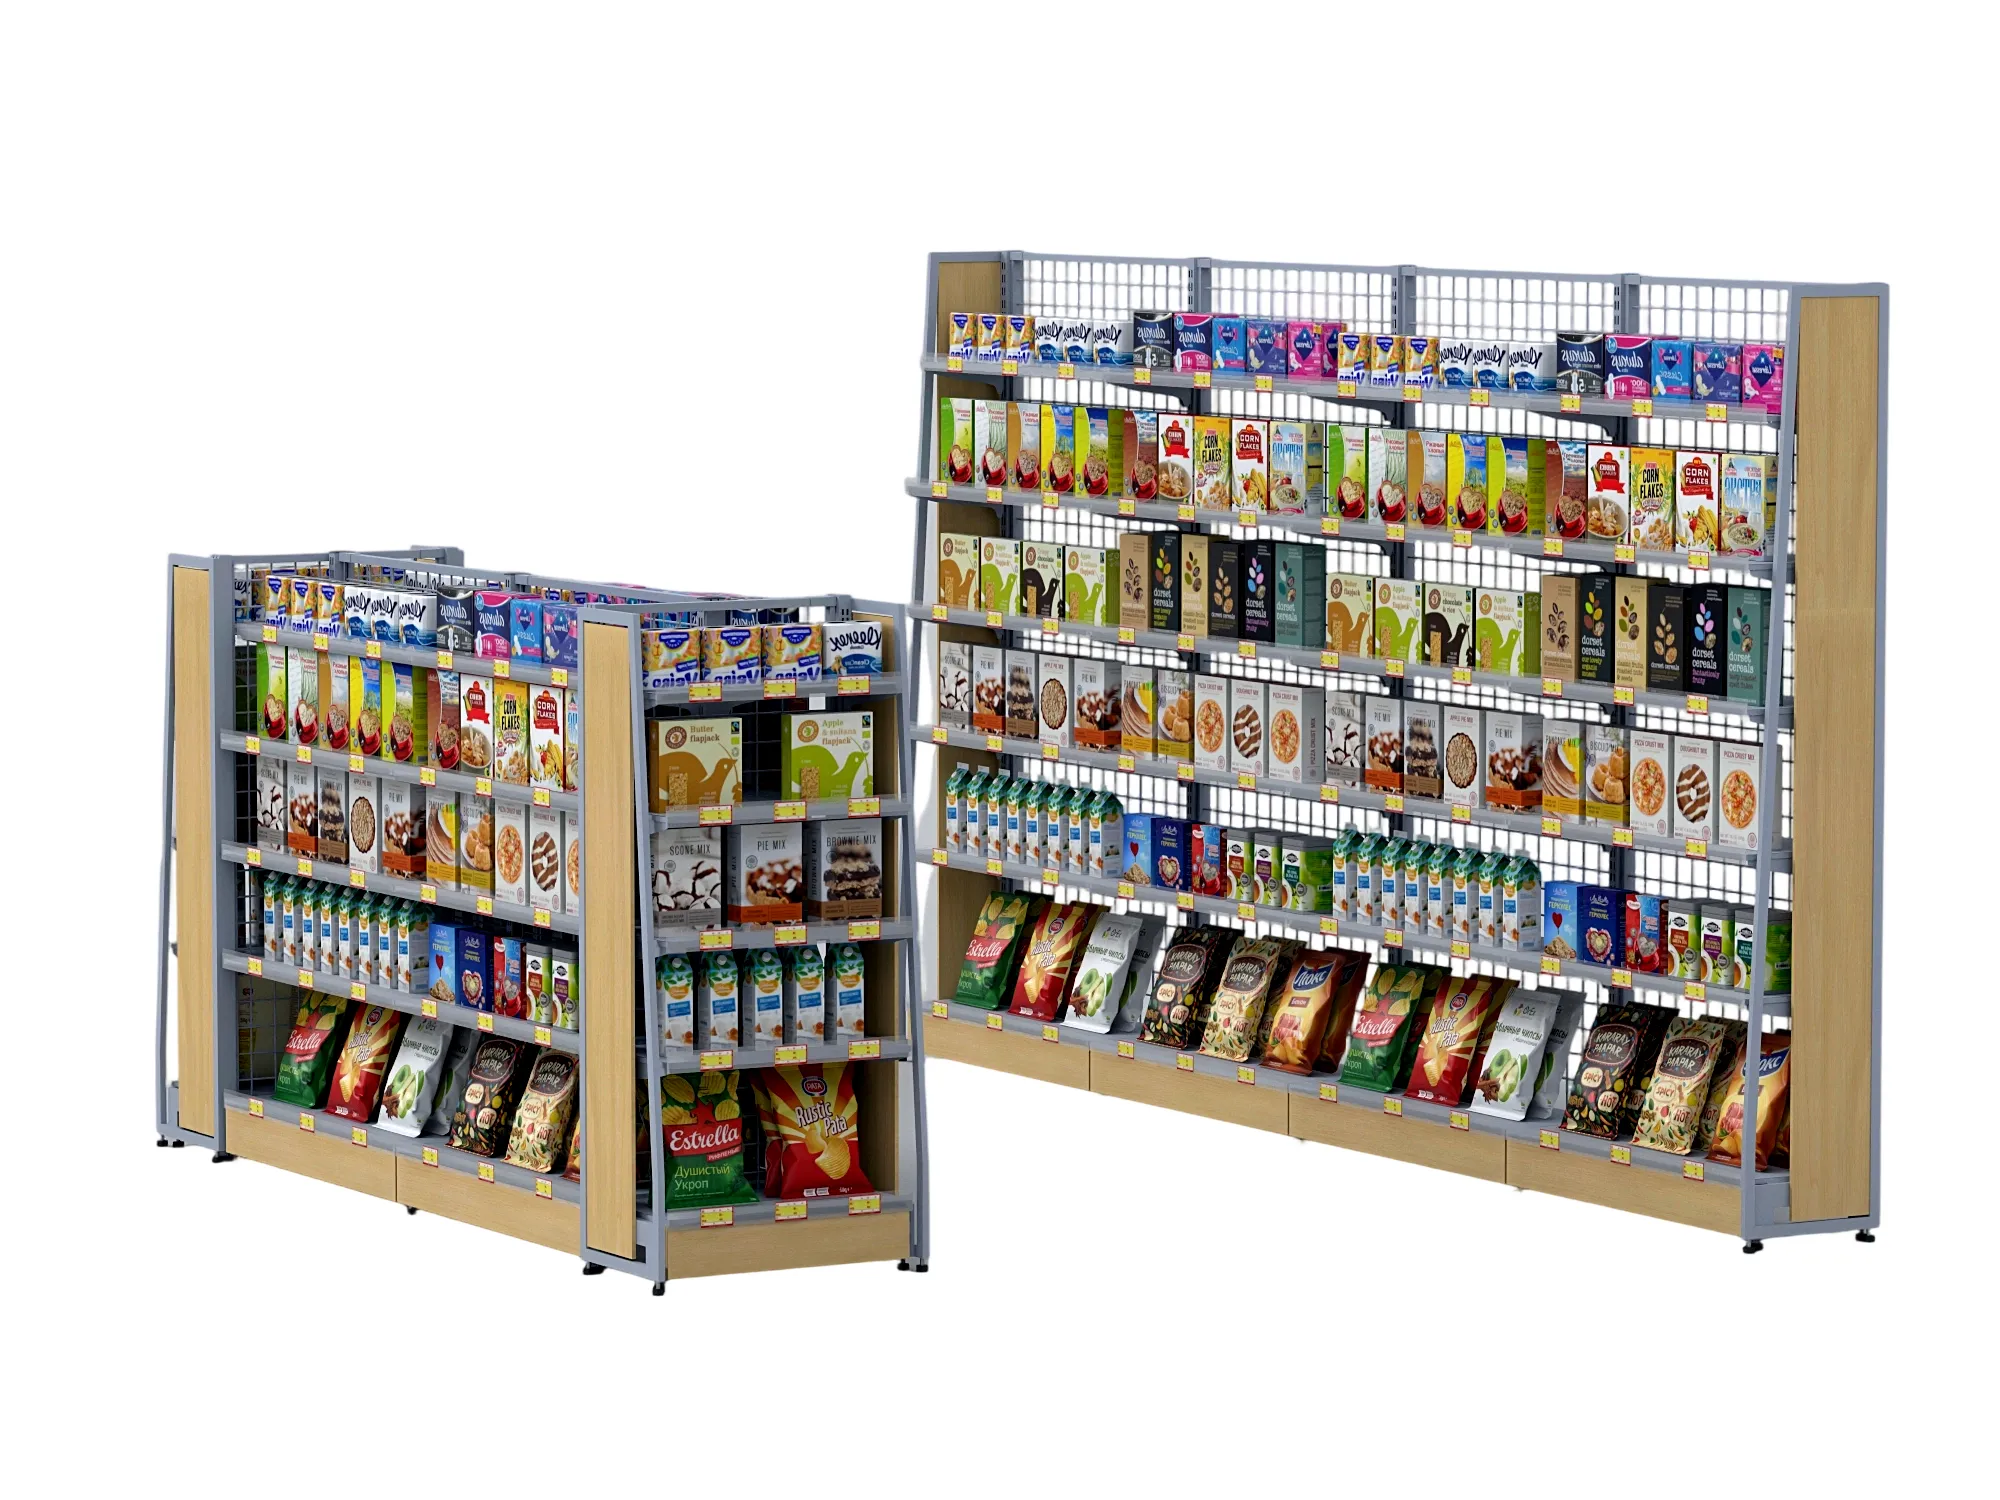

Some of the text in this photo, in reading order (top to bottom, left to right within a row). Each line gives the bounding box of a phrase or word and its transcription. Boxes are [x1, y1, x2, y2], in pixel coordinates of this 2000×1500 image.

[1204, 435, 1218, 449] CORN
[1240, 434, 1260, 443] CORN
[1202, 449, 1222, 463] FLAKES
[1642, 467, 1659, 483] CORN
[1685, 467, 1709, 477] CORN
[1685, 477, 1709, 485] FLAKES
[1639, 484, 1663, 499] FLAKES
[1153, 588, 1172, 597] dorset
[1153, 598, 1174, 608] cereals
[1245, 598, 1264, 608] dorset
[1276, 601, 1295, 611] dorset
[1245, 608, 1267, 618] cereals
[1276, 612, 1298, 622] cereals
[1581, 635, 1603, 646] dorset
[1616, 638, 1637, 649] dorset
[1581, 647, 1605, 657] cereals
[1616, 650, 1640, 661] cereals
[1692, 647, 1714, 658] dorset
[1729, 651, 1752, 663] dorset
[1666, 663, 1680, 671] cereals
[1692, 658, 1717, 670] cereals
[1729, 663, 1754, 674] cereals
[504, 700, 517, 715] CORN
[537, 700, 556, 711] CORN
[537, 710, 556, 719] FLAKES
[1374, 712, 1391, 722] PIE MIX
[1450, 714, 1461, 722] APPLE
[501, 715, 520, 731] FLAKES
[822, 718, 844, 728] Apple
[690, 725, 714, 734] Butter
[1495, 727, 1513, 738] PIE MIX
[690, 733, 720, 745] flapjack
[822, 737, 852, 747] flapjack
[1545, 735, 1566, 746] PANCAKE
[1645, 739, 1655, 747] CRUST
[1590, 740, 1609, 751] BISCUIT
[1680, 745, 1707, 754] DOUGHNUT MIX
[1735, 752, 1746, 760] CRUST
[757, 839, 786, 851] PIE MIX
[826, 834, 877, 848] BROWNIE MIX
[669, 844, 711, 856] SCONE MIX
[1548, 901, 1572, 911] ГЕРКУЛЕС
[1588, 911, 1609, 920] ГЕРКУЛЕС
[966, 939, 1002, 957] Estrella
[1031, 939, 1055, 955] Rustic
[1294, 971, 1327, 987] Люкс
[1159, 987, 1174, 998] SPICY
[1220, 1000, 1236, 1011] SPICY
[1173, 1009, 1188, 1021] HOT
[1234, 1019, 1248, 1031] HOT
[1355, 1015, 1398, 1035] Estrella
[1430, 1016, 1457, 1034] Rustic
[286, 1029, 322, 1049] Estrella
[1440, 1031, 1459, 1047] Pata
[1596, 1030, 1631, 1046] KARARAY
[1668, 1045, 1704, 1059] KARARAY
[1583, 1071, 1601, 1083] SPICY
[806, 1082, 823, 1091] PATA
[1655, 1086, 1674, 1097] SPICY
[467, 1087, 483, 1099] SPICY
[1600, 1095, 1617, 1107] HOT
[525, 1103, 541, 1115] SPICY
[795, 1100, 833, 1128] Rustic
[479, 1112, 495, 1125] HOT
[1673, 1109, 1691, 1121] HOT
[823, 1115, 848, 1138] Pata
[537, 1126, 553, 1139] HOT
[669, 1124, 740, 1152] Estrella
[674, 1163, 730, 1179] Душистый
[674, 1179, 709, 1191] Укроп
